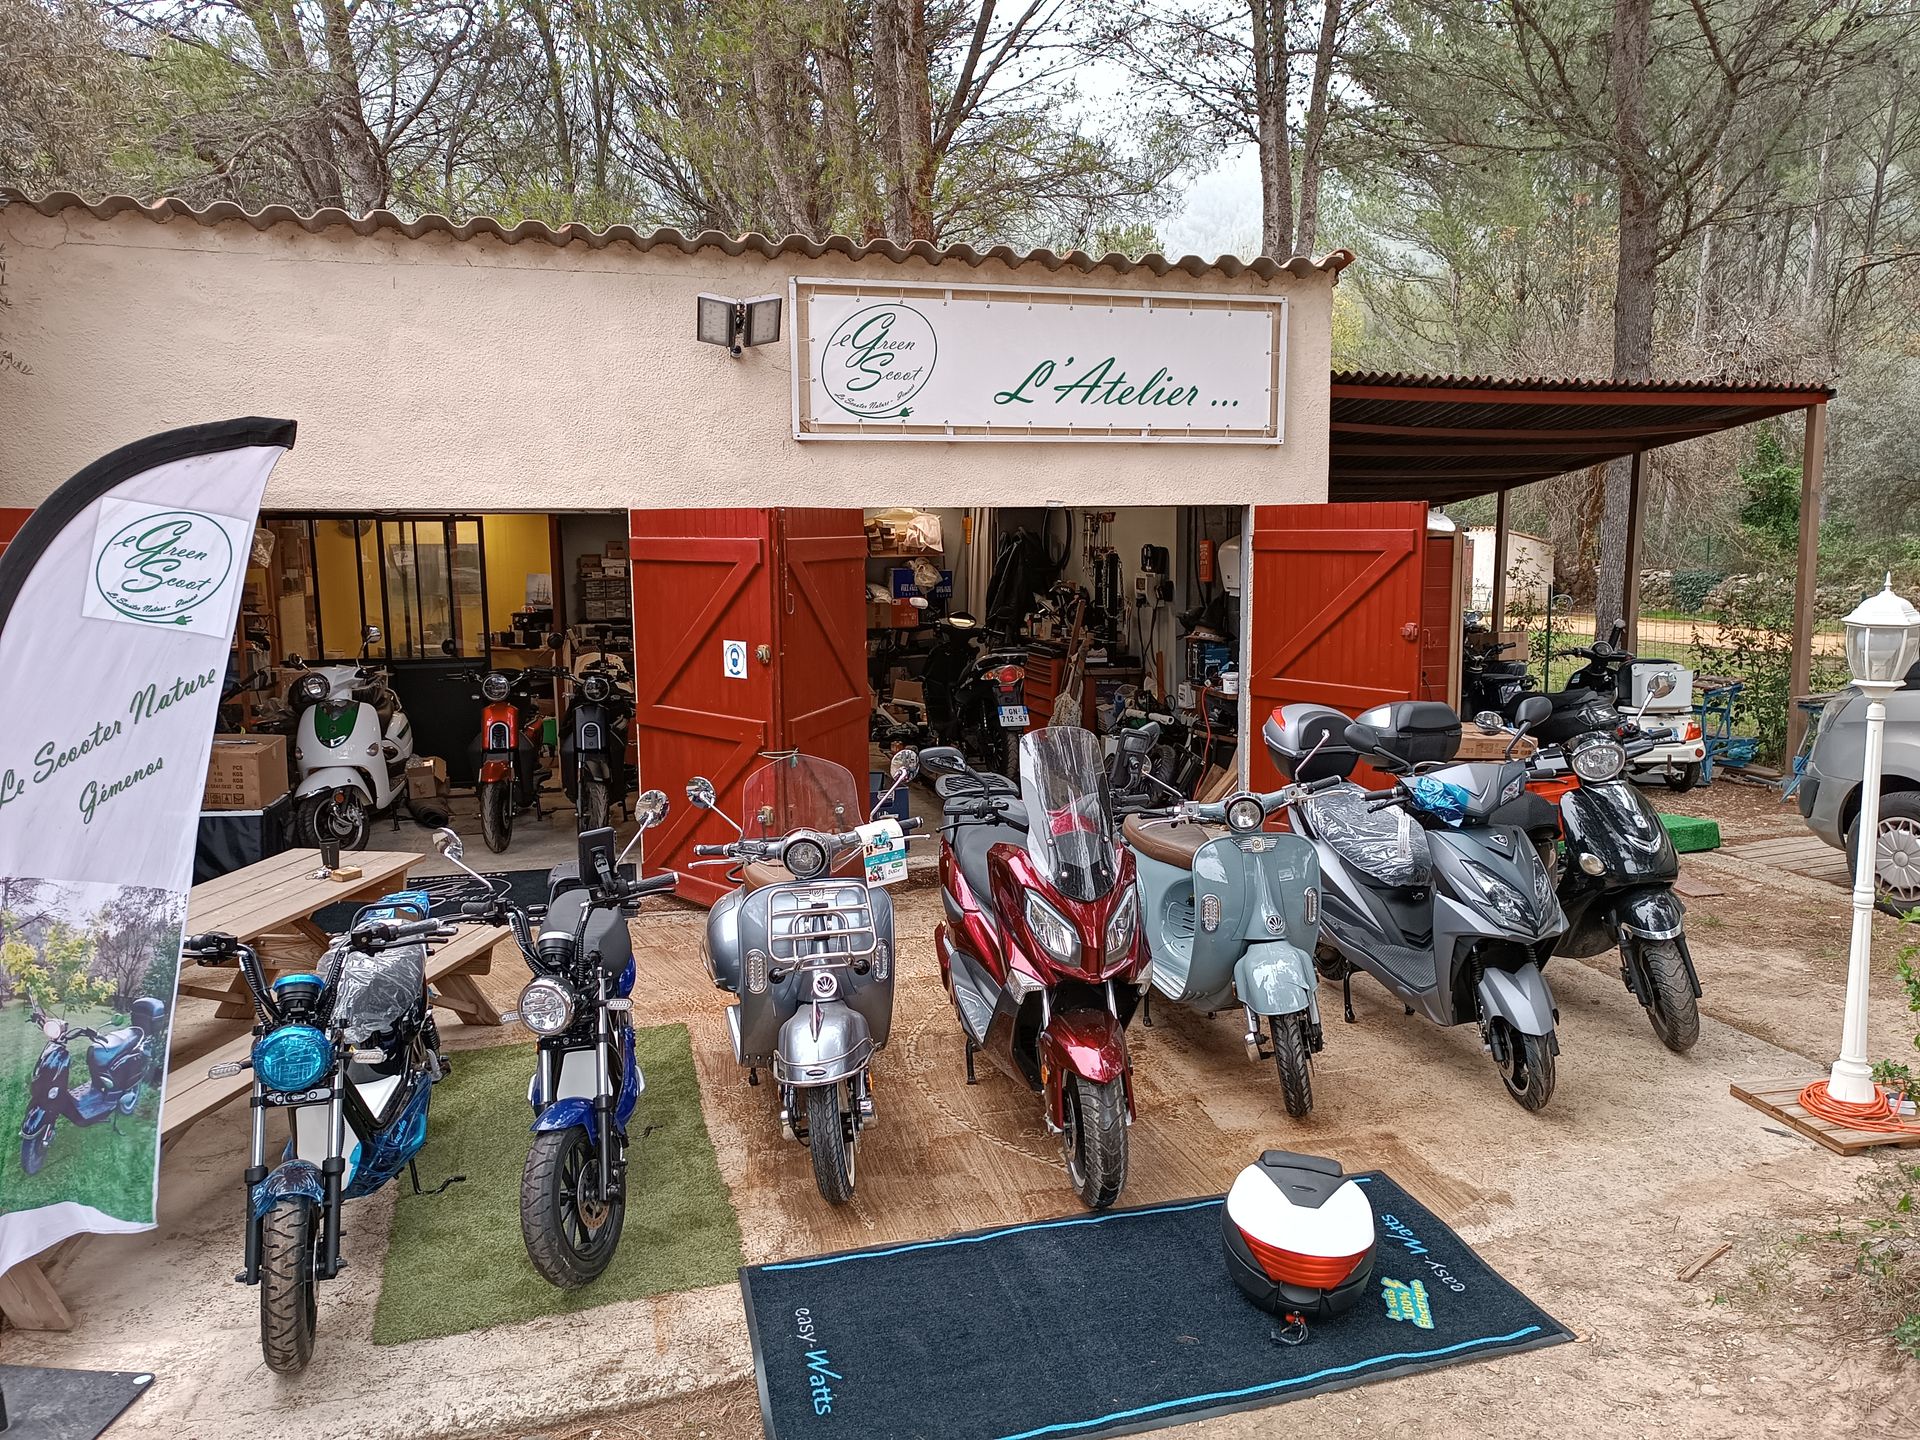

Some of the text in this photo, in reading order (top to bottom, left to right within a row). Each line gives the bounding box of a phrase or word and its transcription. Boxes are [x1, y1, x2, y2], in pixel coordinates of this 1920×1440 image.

[846, 353, 923, 391] Scoot
[994, 356, 1198, 406] L'Atelier
[121, 559, 211, 593] Scoot
[0, 668, 216, 809] Le Scooter Nature
[79, 757, 163, 825] Gémenos
[1381, 1213, 1466, 1292] easy-Watts
[1386, 1289, 1398, 1308] suis
[1400, 1292, 1415, 1319] 100%
[795, 1308, 842, 1416] easy-Watts
